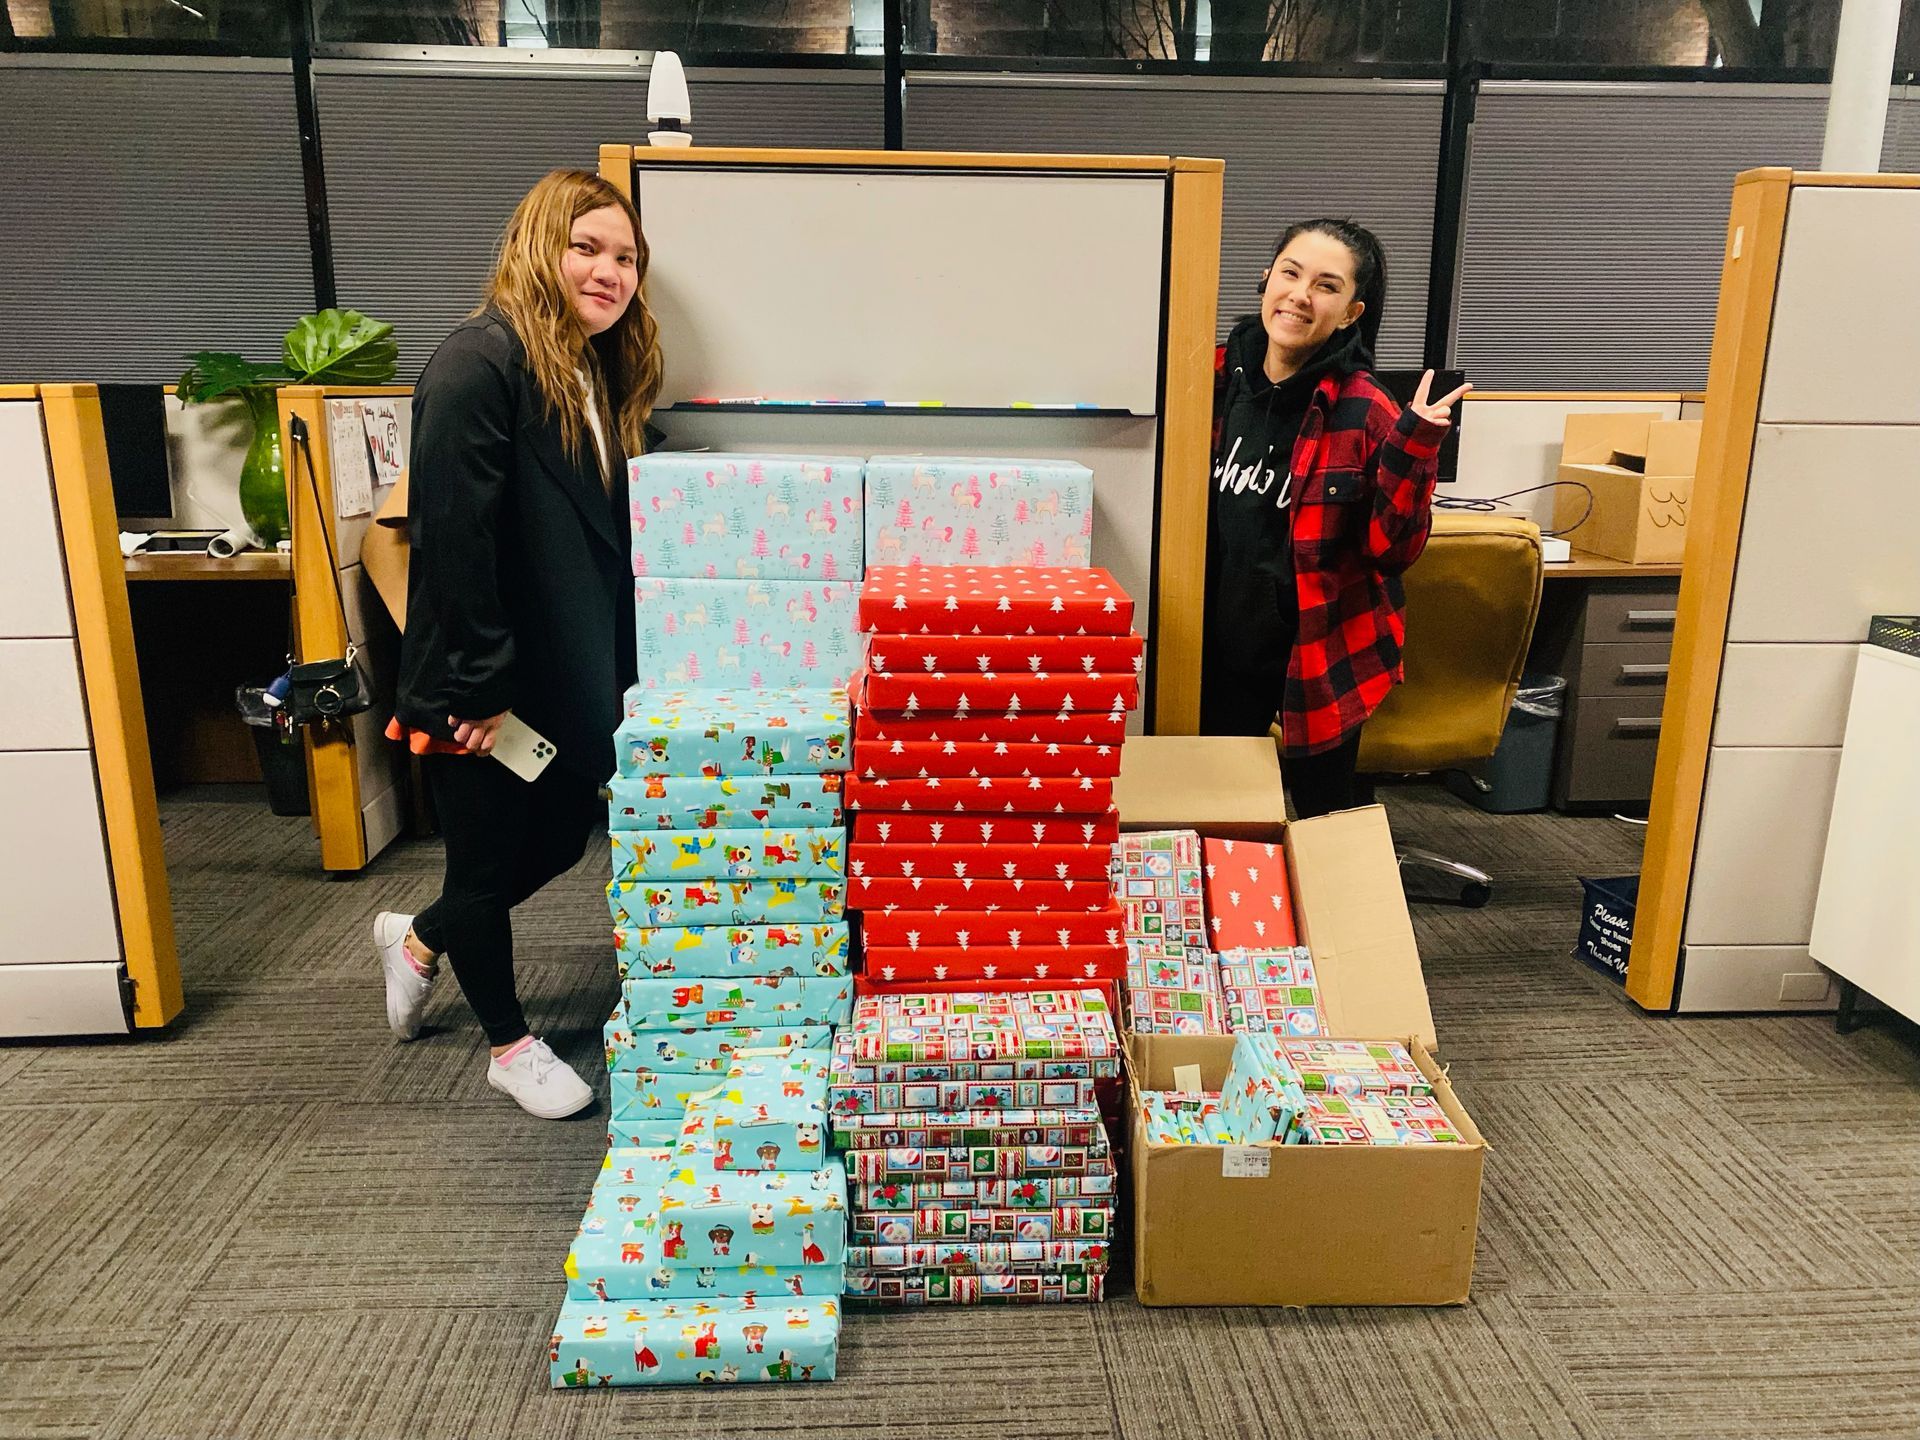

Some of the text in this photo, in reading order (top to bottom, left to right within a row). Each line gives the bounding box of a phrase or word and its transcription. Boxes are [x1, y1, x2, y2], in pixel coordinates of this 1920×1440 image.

[1647, 486, 1688, 528] 33
[1594, 903, 1630, 931] Please,
[1612, 930, 1632, 946] Remo
[1586, 940, 1628, 974] Thank Yo
